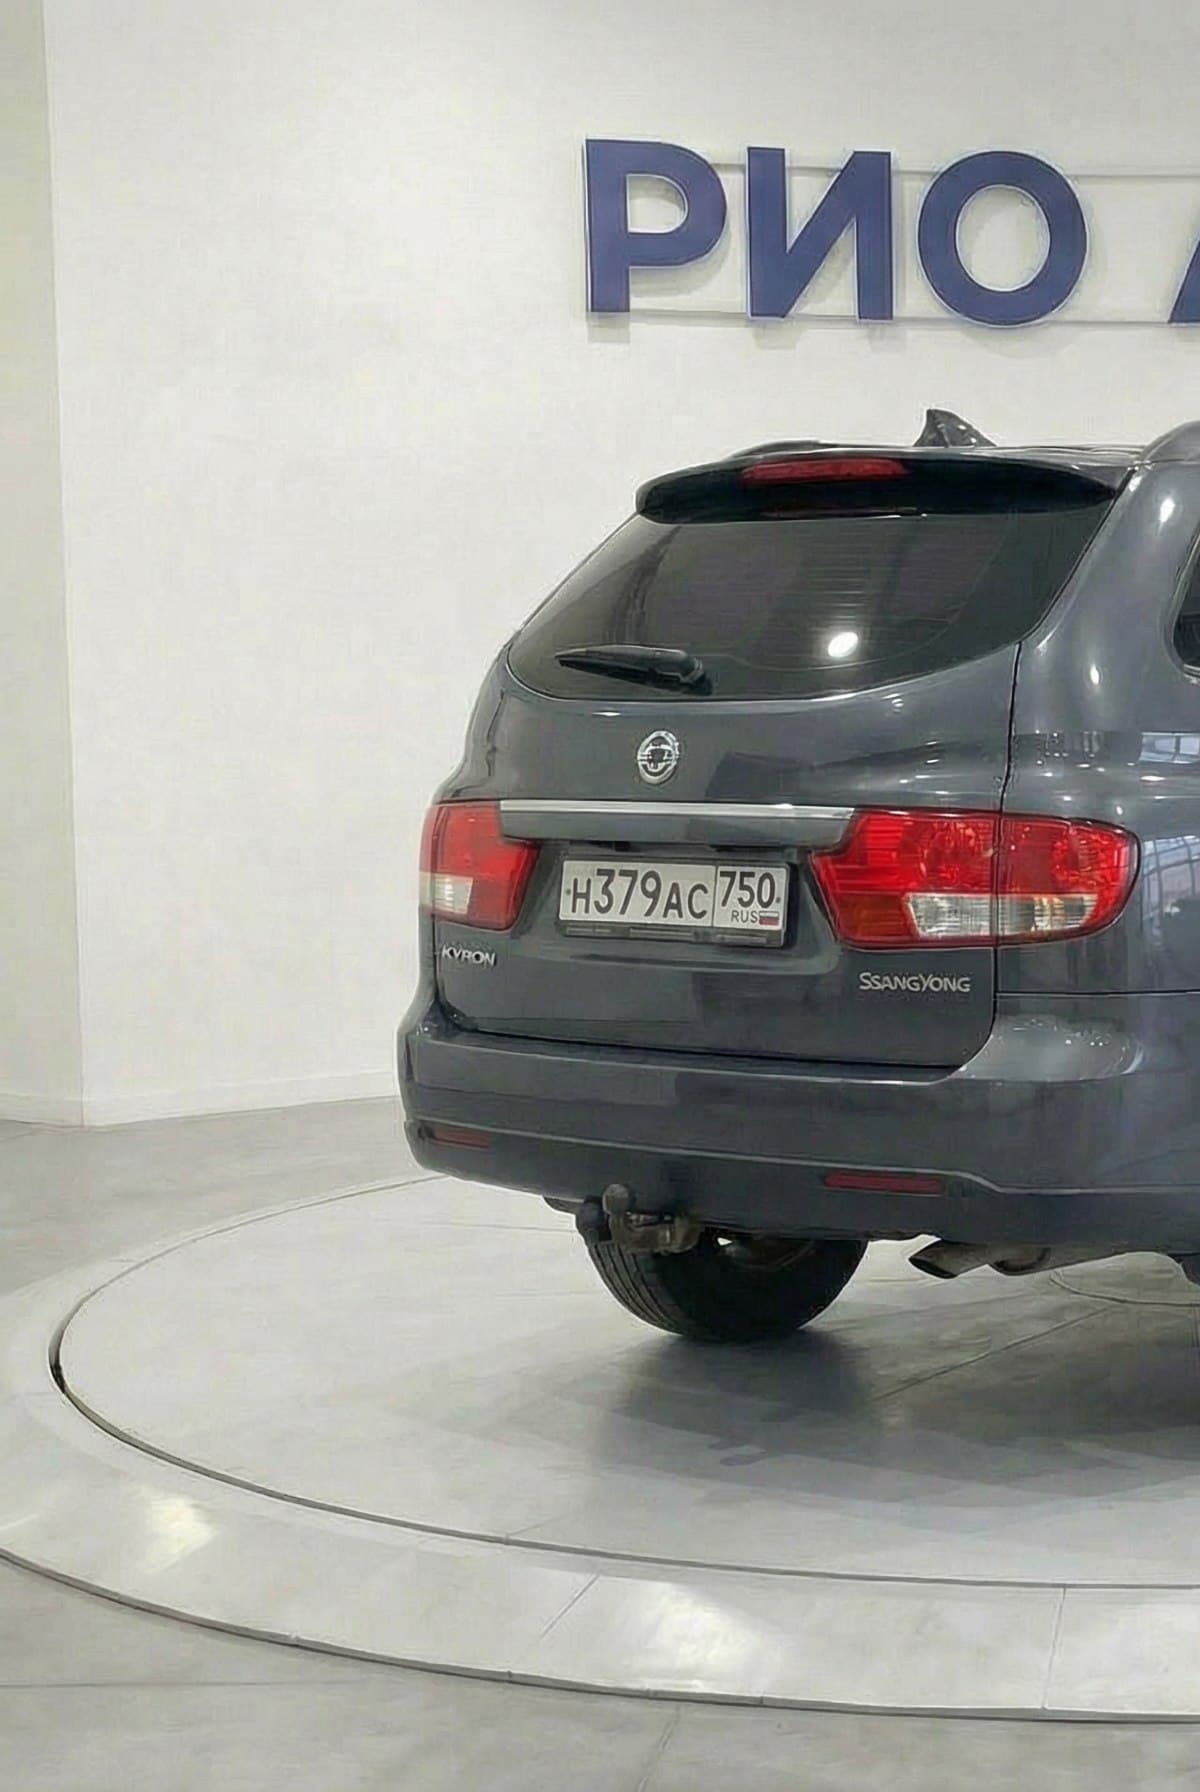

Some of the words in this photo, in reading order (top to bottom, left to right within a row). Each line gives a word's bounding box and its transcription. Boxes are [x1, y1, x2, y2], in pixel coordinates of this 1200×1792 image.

[584, 138, 1088, 326] РИО
[571, 868, 709, 919] Н379АС
[719, 871, 776, 908] 750
[731, 910, 758, 923] RUS
